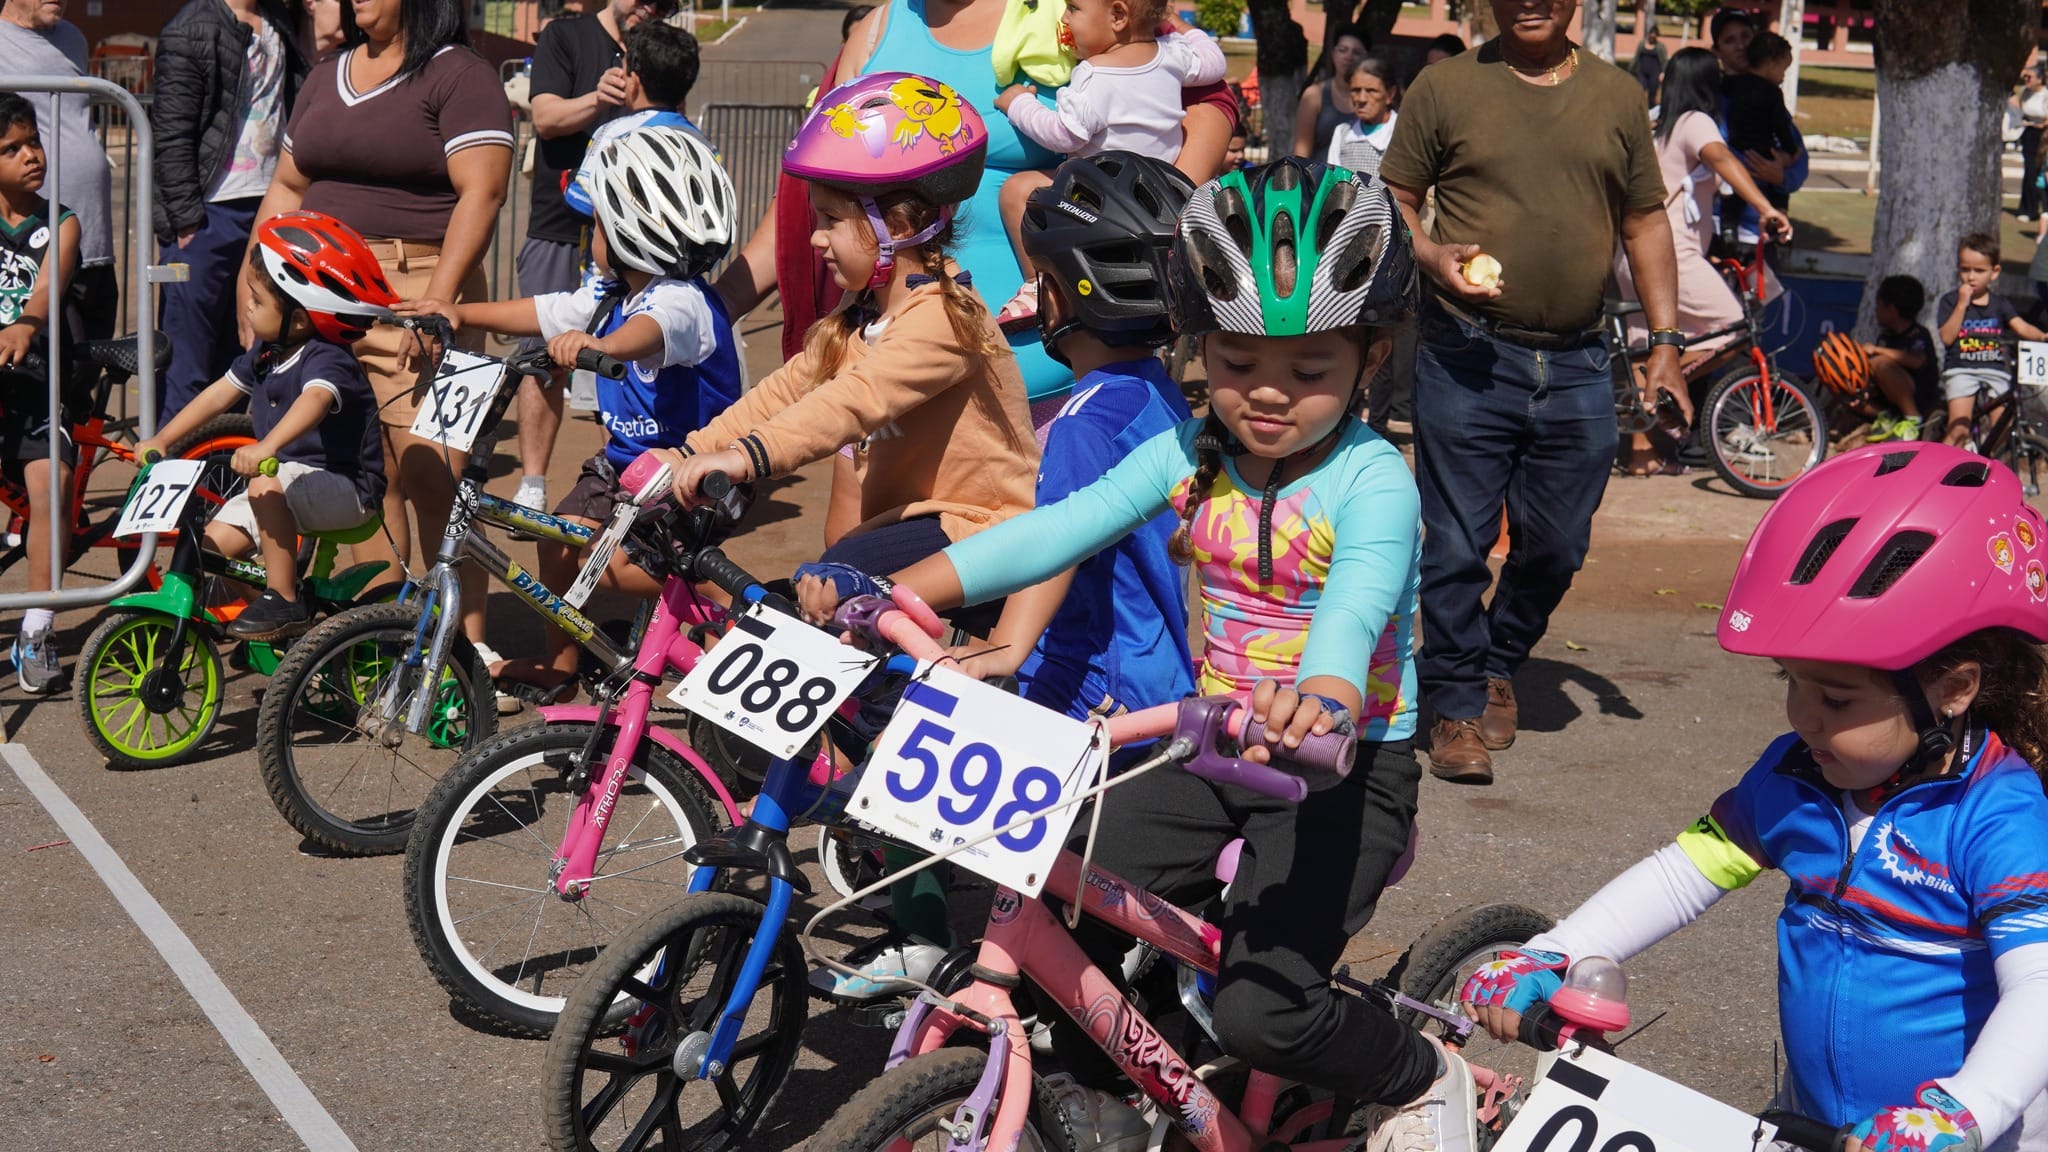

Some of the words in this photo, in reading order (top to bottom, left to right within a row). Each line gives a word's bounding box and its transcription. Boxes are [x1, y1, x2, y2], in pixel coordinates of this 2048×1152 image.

[1057, 200, 1098, 223] SPECIALIZED
[431, 381, 487, 434] 131
[129, 483, 191, 522] 127
[511, 571, 567, 615] BMX
[707, 643, 836, 733] 088
[885, 719, 1061, 853] 598
[1925, 875, 1956, 893] Bike
[1526, 1105, 1656, 1152] 0
